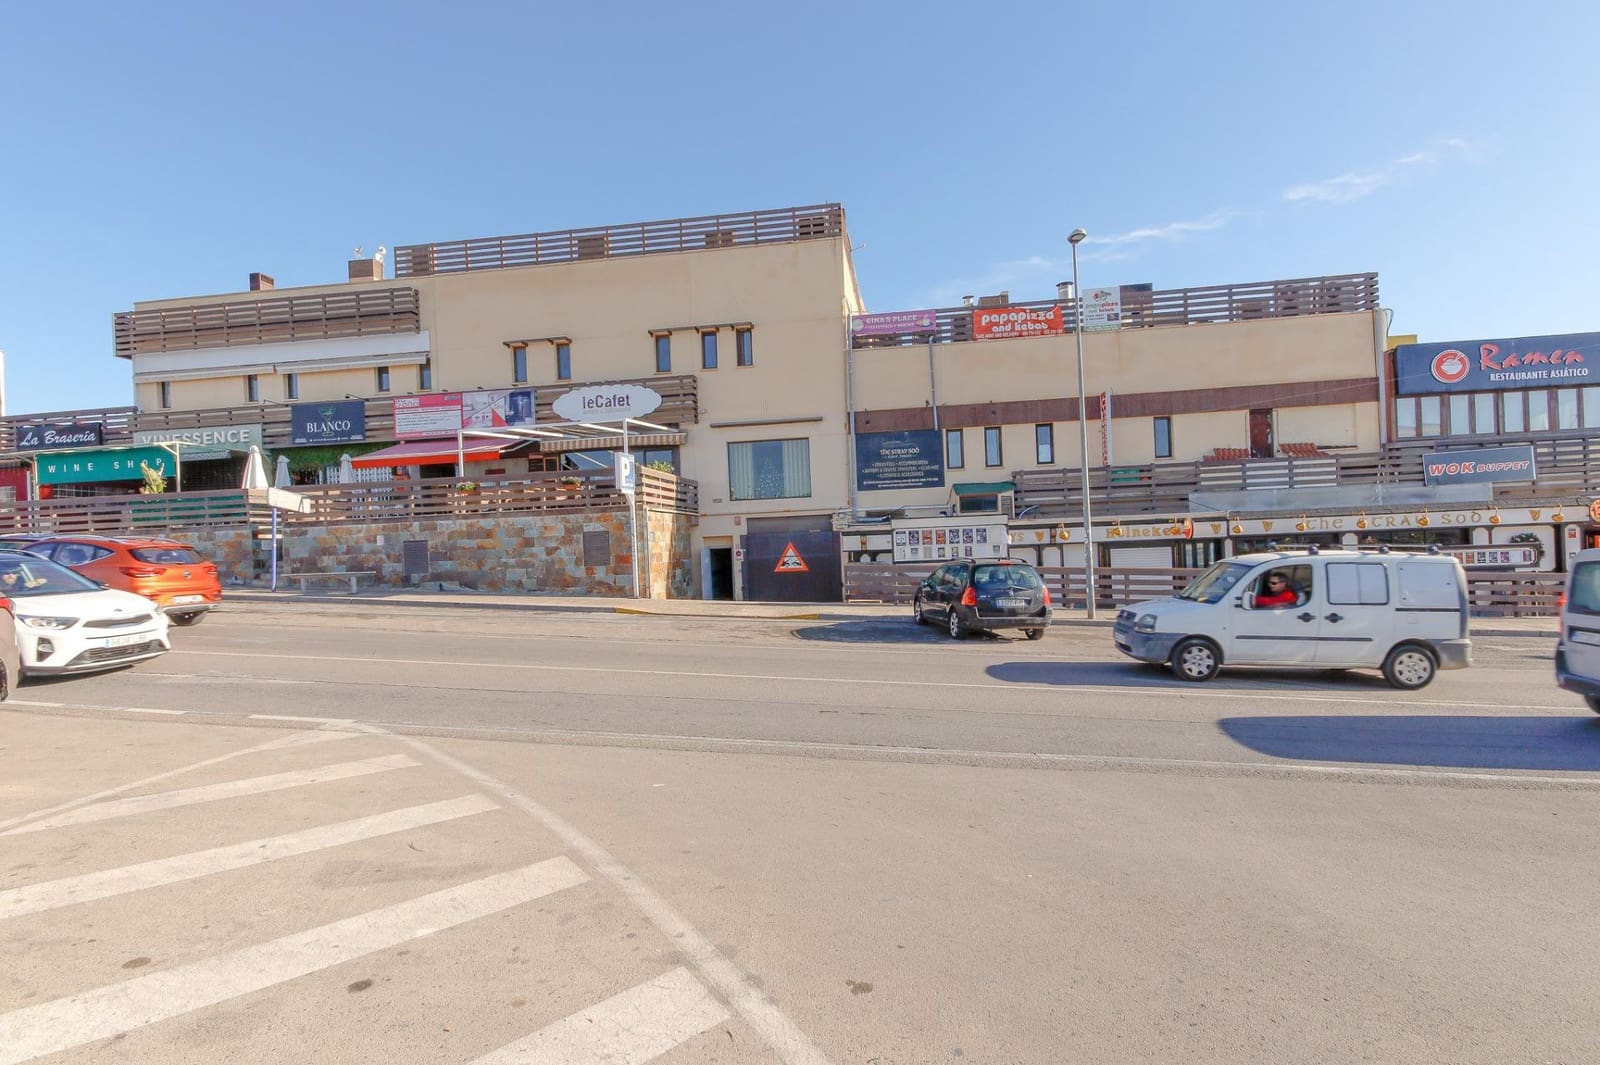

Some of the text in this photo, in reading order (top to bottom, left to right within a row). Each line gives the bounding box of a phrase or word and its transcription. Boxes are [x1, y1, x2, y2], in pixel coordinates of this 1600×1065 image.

[981, 310, 1054, 326] papapizza
[992, 321, 1048, 332] and kebab
[1480, 343, 1585, 371] Ramen
[1490, 367, 1589, 381] RESTAURANTE ASIÁTICO
[582, 394, 631, 409] leCafet
[306, 420, 351, 433] BLANCO
[19, 430, 97, 446] La Brasería
[142, 429, 251, 446] VINESSENCE
[48, 458, 162, 473] WINE SHOP
[621, 456, 631, 487] P
[1428, 460, 1530, 477] WOK BUFFET
